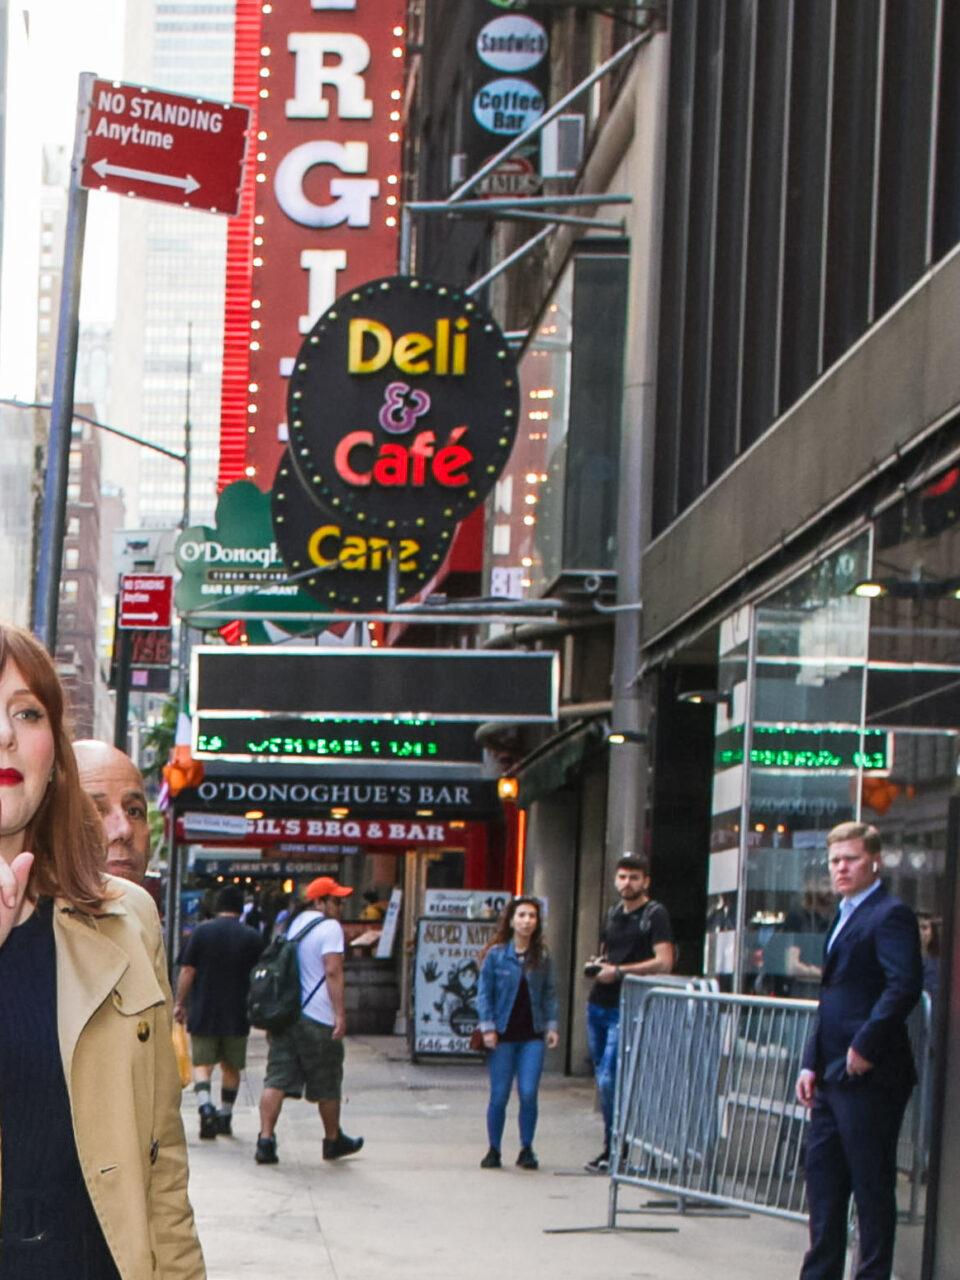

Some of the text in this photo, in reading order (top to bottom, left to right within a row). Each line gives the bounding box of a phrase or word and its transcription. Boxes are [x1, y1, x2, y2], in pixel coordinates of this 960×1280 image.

[98, 91, 223, 133] NO STANDING
[478, 91, 545, 111] Coffee
[95, 117, 174, 150] Anytime
[493, 111, 525, 129] Bar
[348, 316, 470, 376] Deli
[379, 381, 431, 434] &
[334, 426, 473, 486] Café
[198, 782, 471, 804] O'DONOGHUE'S BAR
[307, 821, 360, 838] BBQ
[367, 822, 383, 839] &
[388, 824, 445, 841] BAR
